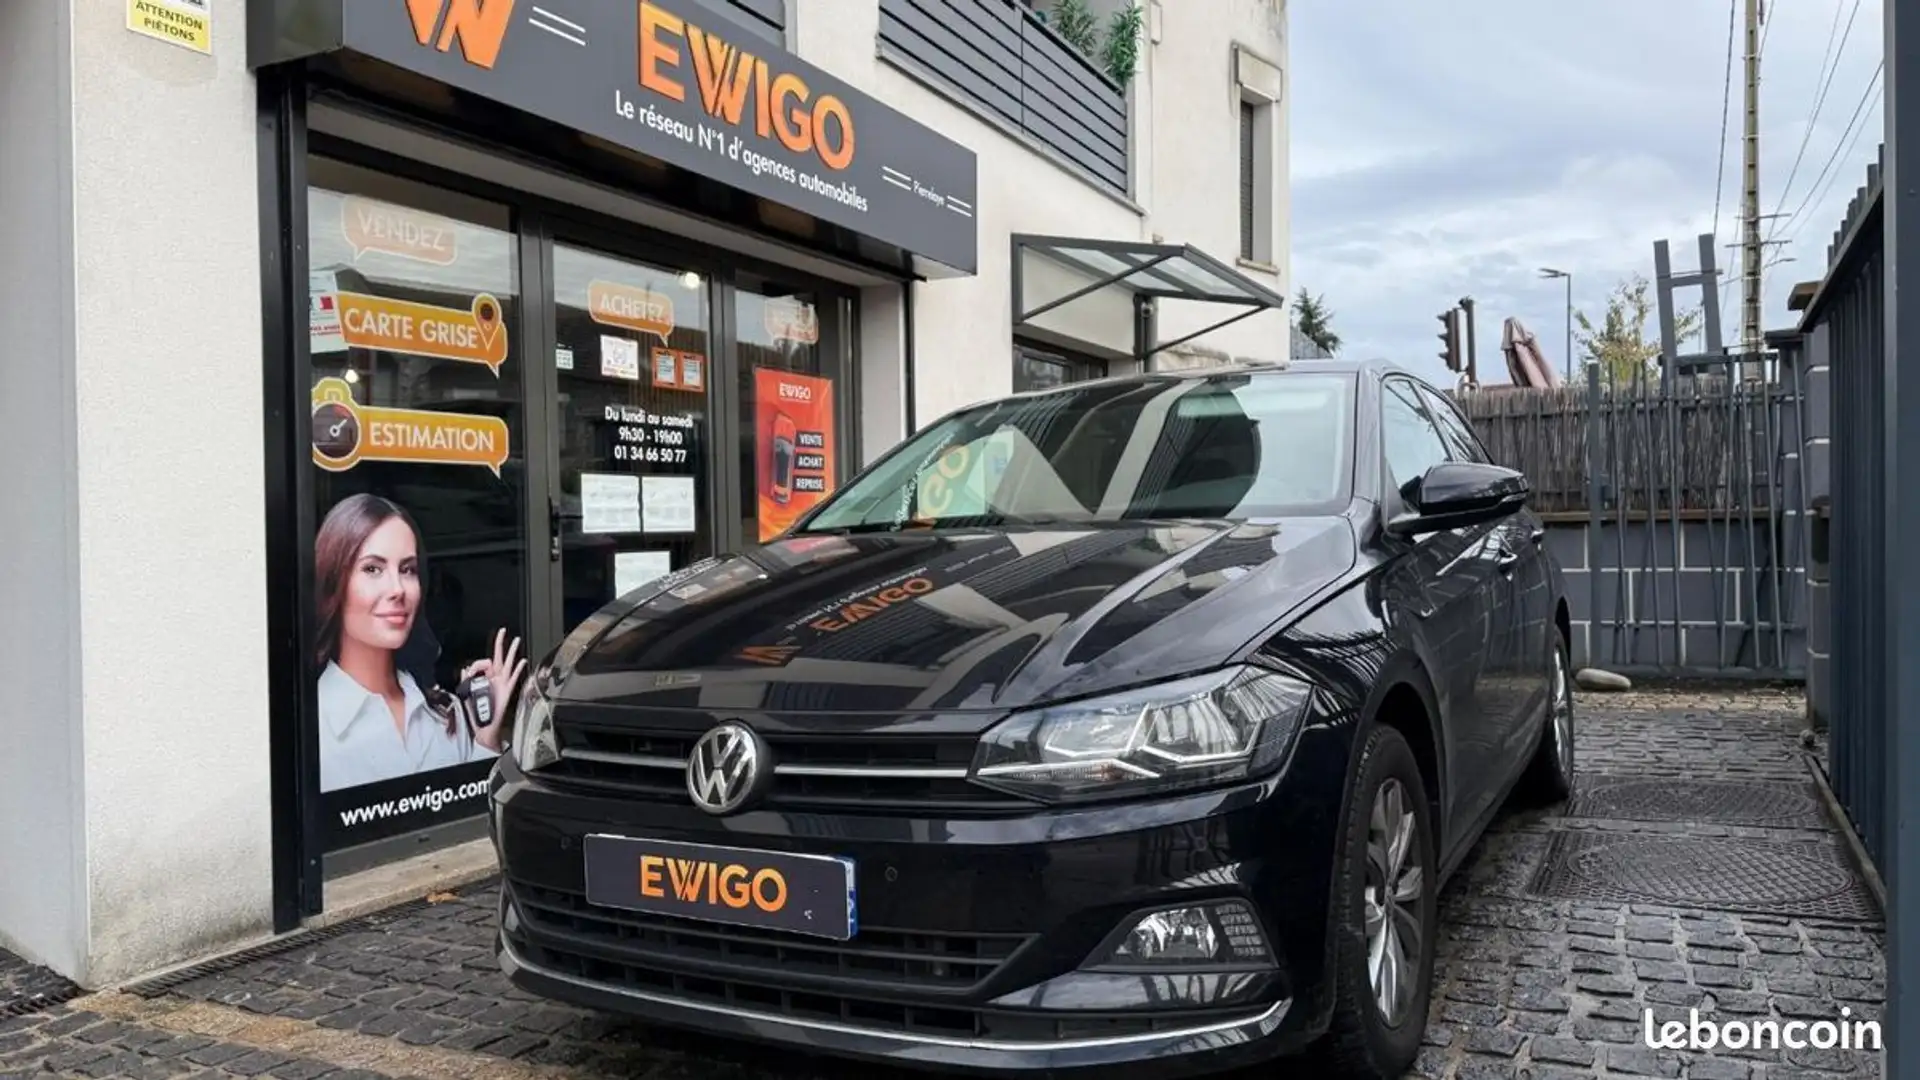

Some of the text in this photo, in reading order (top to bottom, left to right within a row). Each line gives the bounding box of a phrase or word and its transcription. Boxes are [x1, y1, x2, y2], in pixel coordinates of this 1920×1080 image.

[136, 1, 203, 30] ATTENTION
[637, 0, 855, 170] EWIGO
[615, 89, 635, 119] Le
[639, 104, 694, 142] réseau
[799, 172, 868, 212] automobiles
[357, 207, 446, 251] VENDEZ
[600, 294, 665, 322] ACHETEZ
[344, 308, 413, 340] CARTE
[420, 319, 477, 347] GRISE
[779, 382, 811, 399] EWIGO
[605, 406, 694, 428] Du lundi au samedi
[370, 422, 495, 452] ESTIMATION
[619, 426, 645, 442] 9h30
[653, 429, 683, 445] 19h00
[799, 433, 823, 446] VENTE
[614, 445, 687, 463] 01 34 66 50 77
[798, 455, 823, 467] ACHAT
[796, 477, 823, 490] REPRISE
[640, 855, 788, 913] EWIGO
